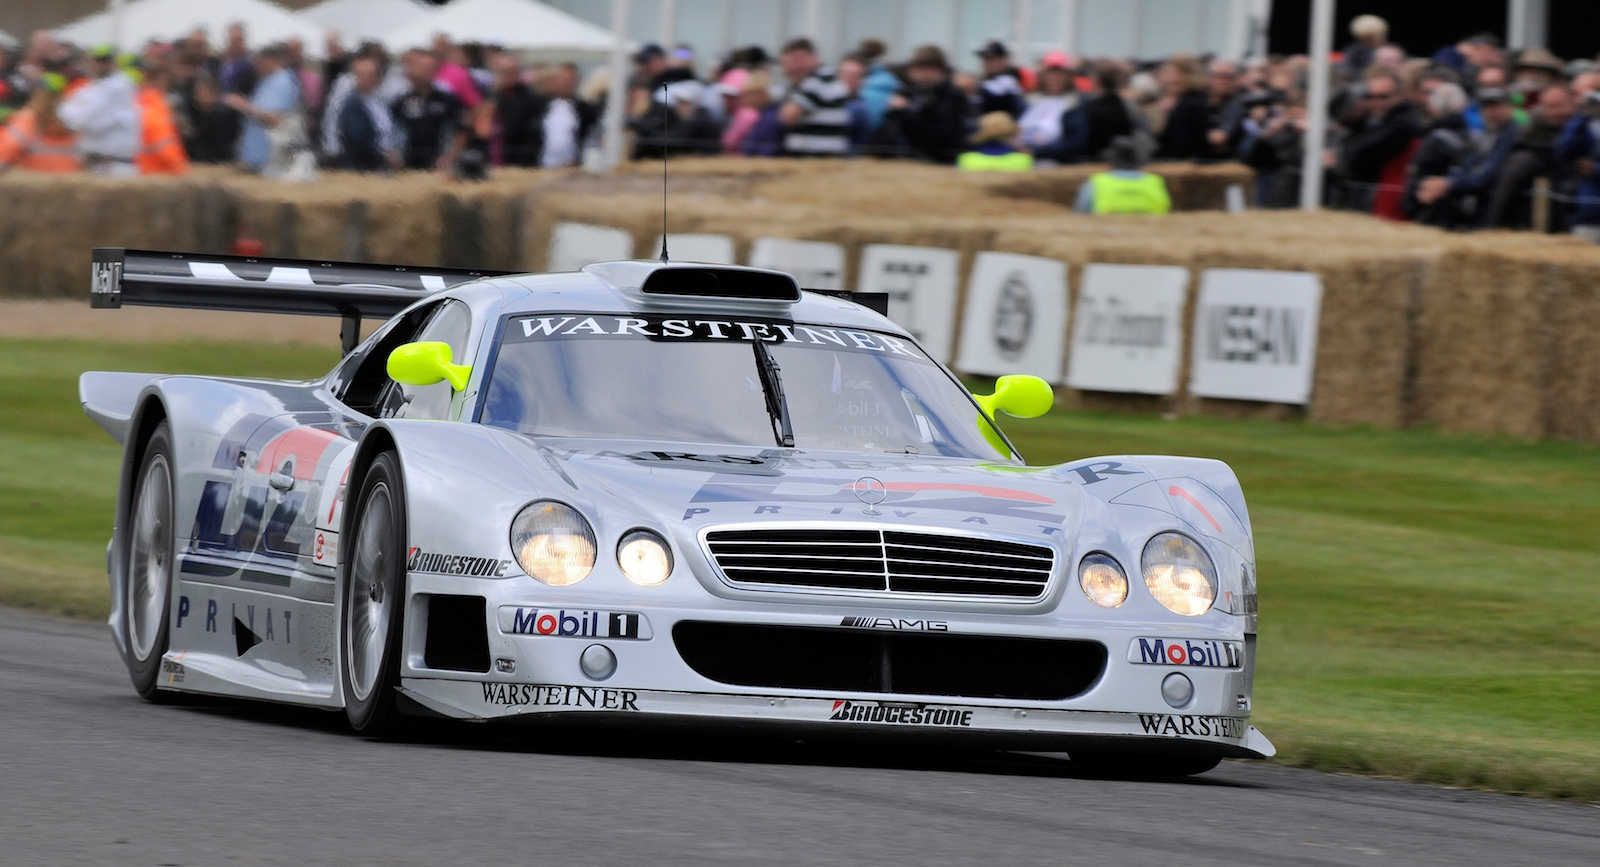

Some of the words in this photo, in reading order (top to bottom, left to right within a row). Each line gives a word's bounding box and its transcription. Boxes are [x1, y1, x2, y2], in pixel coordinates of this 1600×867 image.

[519, 315, 922, 361] WARSTEINER
[683, 505, 1062, 536] PRIVAT
[408, 546, 513, 578] BRIDGESTONE
[176, 595, 292, 644] PRIVAT
[513, 608, 598, 637] Mobil
[872, 617, 948, 632] AMG
[1139, 638, 1221, 667] Mobil
[482, 682, 640, 712] WARSTEINER
[830, 699, 973, 727] BRIDGESTONE
